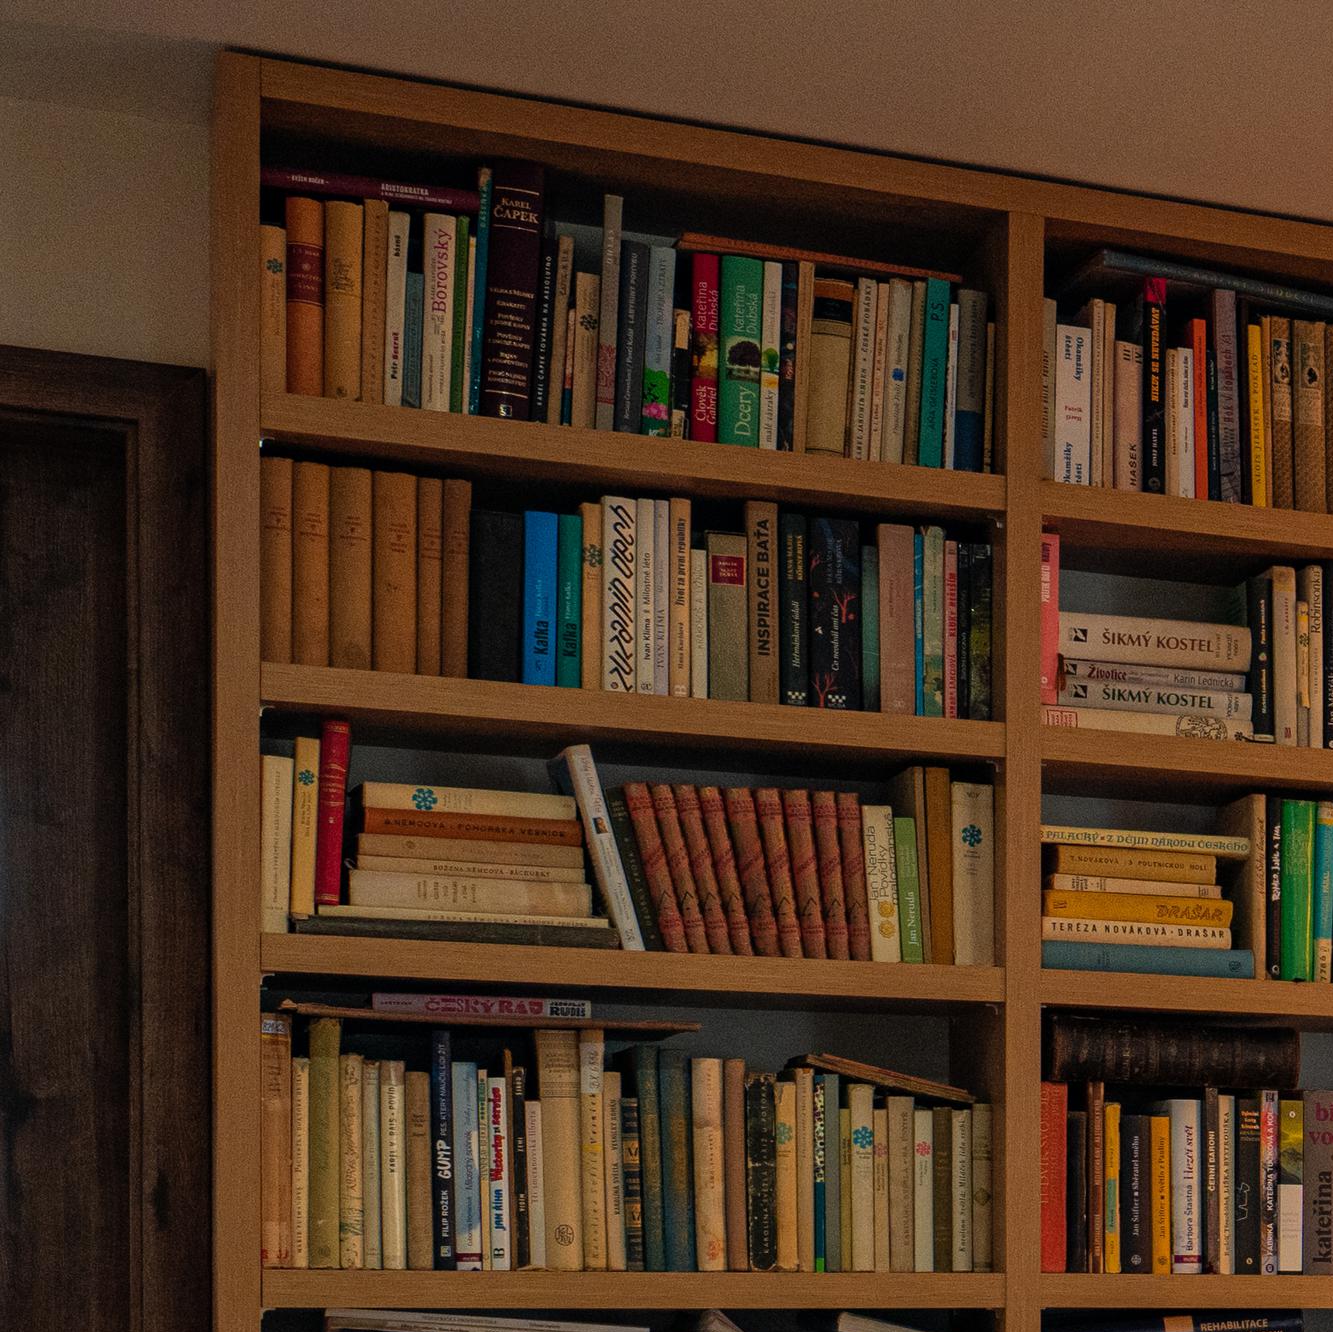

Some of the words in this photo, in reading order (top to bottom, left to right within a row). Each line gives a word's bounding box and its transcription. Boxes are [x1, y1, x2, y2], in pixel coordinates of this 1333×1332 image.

[493, 208, 539, 225] ČAPEK
[432, 229, 451, 313] Borovský
[696, 282, 707, 329] Kateřina
[733, 285, 745, 333] Kateřina
[746, 293, 758, 334] Dubská
[695, 385, 707, 422] Člověk
[707, 386, 718, 425] Gabriel
[734, 385, 756, 436] Dcery
[1129, 443, 1137, 486] HAŠEK
[755, 519, 769, 560] BAŤA
[757, 568, 770, 656] INSPIRACE
[534, 621, 549, 655] Kafka
[563, 624, 577, 658] Kafka
[1102, 628, 1152, 647] ŠIKMÝ
[1156, 636, 1214, 653] KOSTEL
[1102, 685, 1152, 703] ŠIKMÝ
[1156, 692, 1214, 709] KOSTEL
[866, 826, 878, 876] Neruda
[877, 845, 889, 898] Povídky
[868, 881, 879, 902] Jan
[906, 891, 916, 927] Neruda
[908, 930, 919, 945] Jan
[436, 1139, 452, 1179] GUMP
[1207, 1164, 1216, 1191] ČERNÍ
[440, 1190, 449, 1216] ROŽEK
[492, 1189, 504, 1212] ŘÍHA
[1313, 1171, 1333, 1263] kateřina
[440, 1217, 449, 1237] FILIP
[494, 1213, 505, 1231] JAN
[1199, 1319, 1269, 1332] REHABILITACE
